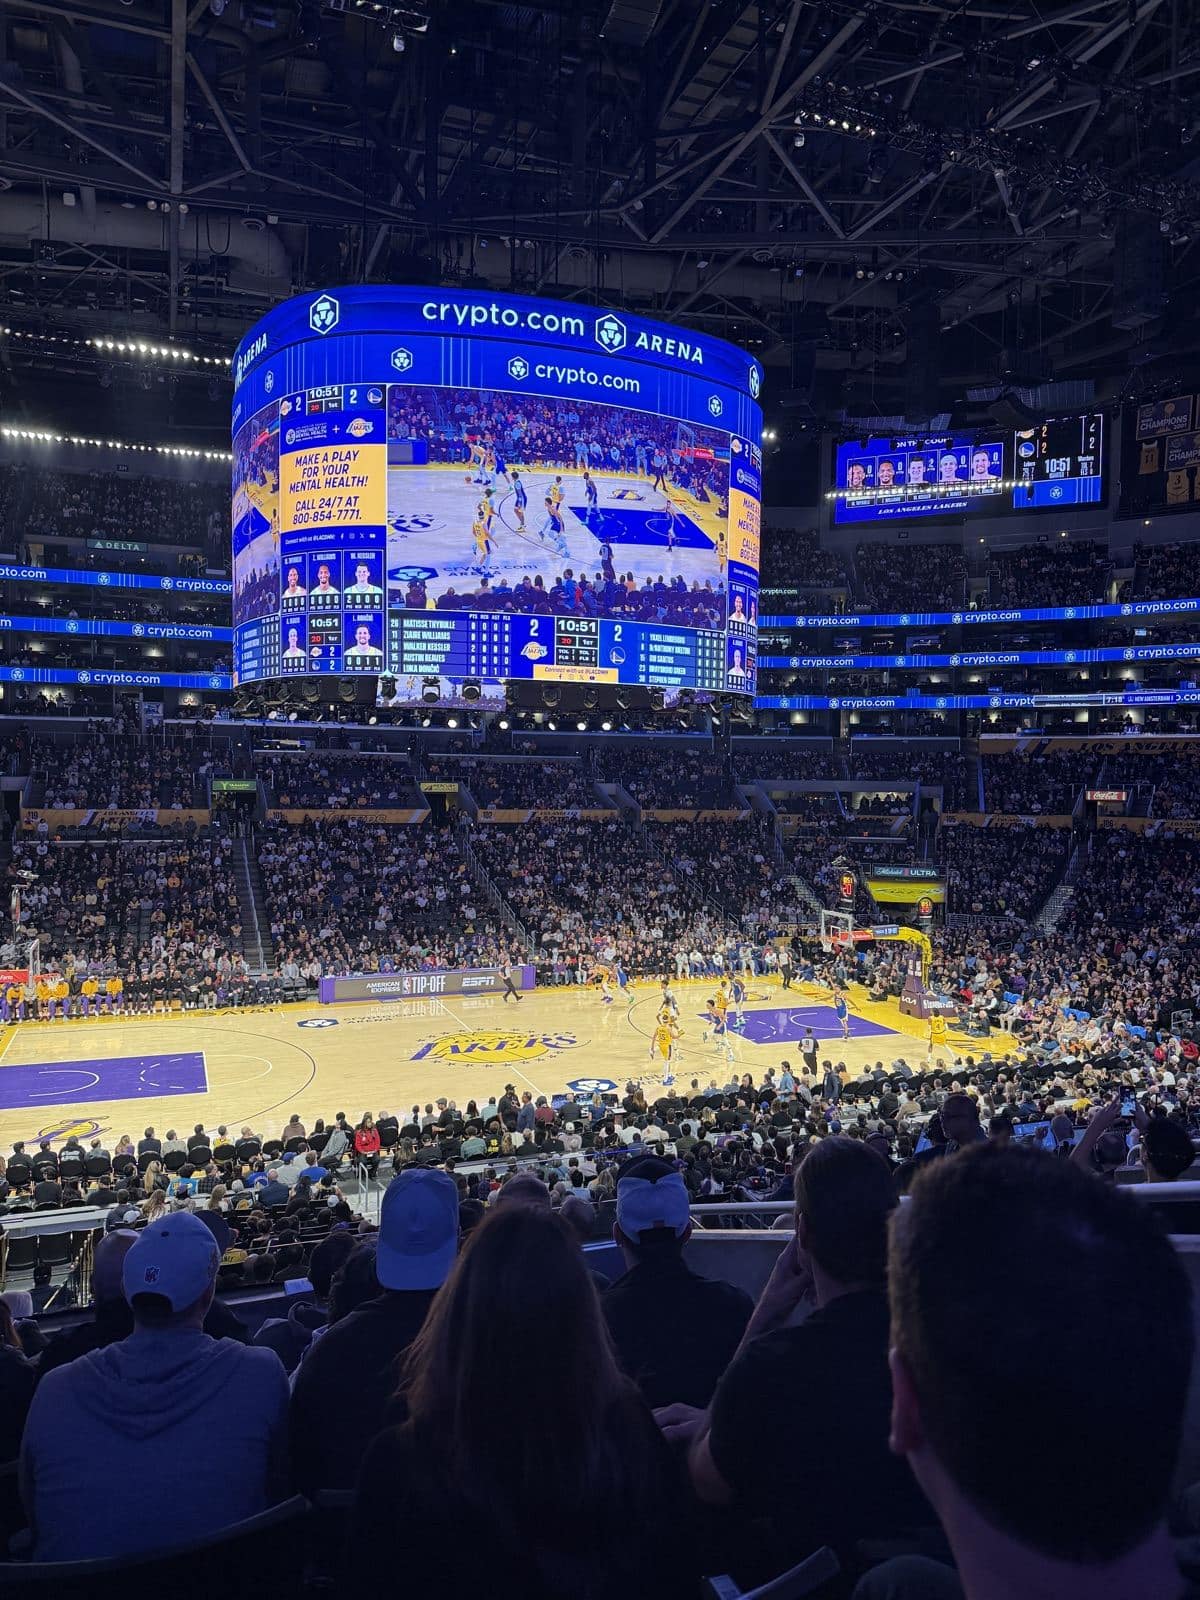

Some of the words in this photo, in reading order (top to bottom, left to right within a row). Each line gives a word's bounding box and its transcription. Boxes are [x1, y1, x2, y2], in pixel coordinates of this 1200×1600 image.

[422, 302, 584, 337] crypto.com
[635, 331, 703, 365] ARENA
[535, 362, 640, 394] crypto.com
[309, 386, 339, 399] 10:51
[350, 389, 357, 404] 2
[296, 397, 301, 411] 2
[1140, 415, 1188, 431] CHAMPIONS
[1042, 426, 1048, 437] 2
[1042, 442, 1047, 454] 2
[1090, 437, 1095, 449] 2
[295, 453, 320, 467] MAKE
[322, 453, 328, 463] A
[332, 450, 359, 463] PLAY
[961, 455, 966, 465] 0
[993, 452, 998, 461] 0
[867, 465, 872, 474] 0
[898, 461, 903, 471] 0
[929, 459, 934, 468] 2
[1045, 457, 1071, 474] 10:51
[302, 467, 318, 478] FOR
[322, 464, 350, 476] YOUR
[290, 480, 321, 494] MENTAL
[325, 476, 369, 489] HEALTH!
[296, 500, 317, 512] CALL
[319, 497, 343, 509] 24/7
[345, 496, 359, 507] AT
[933, 502, 968, 510] LAKERS
[293, 509, 362, 524] 800-854-7771.
[106, 542, 140, 551] DELTA
[1136, 601, 1197, 613] crypto.com
[808, 617, 860, 626] crypto.com
[965, 611, 1021, 622] crypto.com
[310, 618, 339, 628] 10:51
[530, 619, 539, 637] 2
[558, 620, 596, 633] 10:51
[148, 626, 213, 638] crypto.com
[392, 631, 398, 639] 11
[614, 625, 622, 642] 2
[330, 647, 335, 657] 2
[1138, 646, 1200, 657] crypto.com
[330, 660, 335, 670] 2
[802, 658, 854, 667] crypto.com
[963, 654, 1020, 665] crypto.com
[391, 664, 399, 672] 77
[94, 672, 160, 685] crypto.com
[842, 698, 895, 708] crypto.com
[1080, 742, 1114, 751] LOS
[1093, 791, 1118, 800] Coca-Cola
[366, 981, 400, 989] AMERICAN
[412, 975, 446, 994] TIP-OFF
[462, 976, 496, 987] ESPN
[410, 1036, 577, 1060] LAKERS
